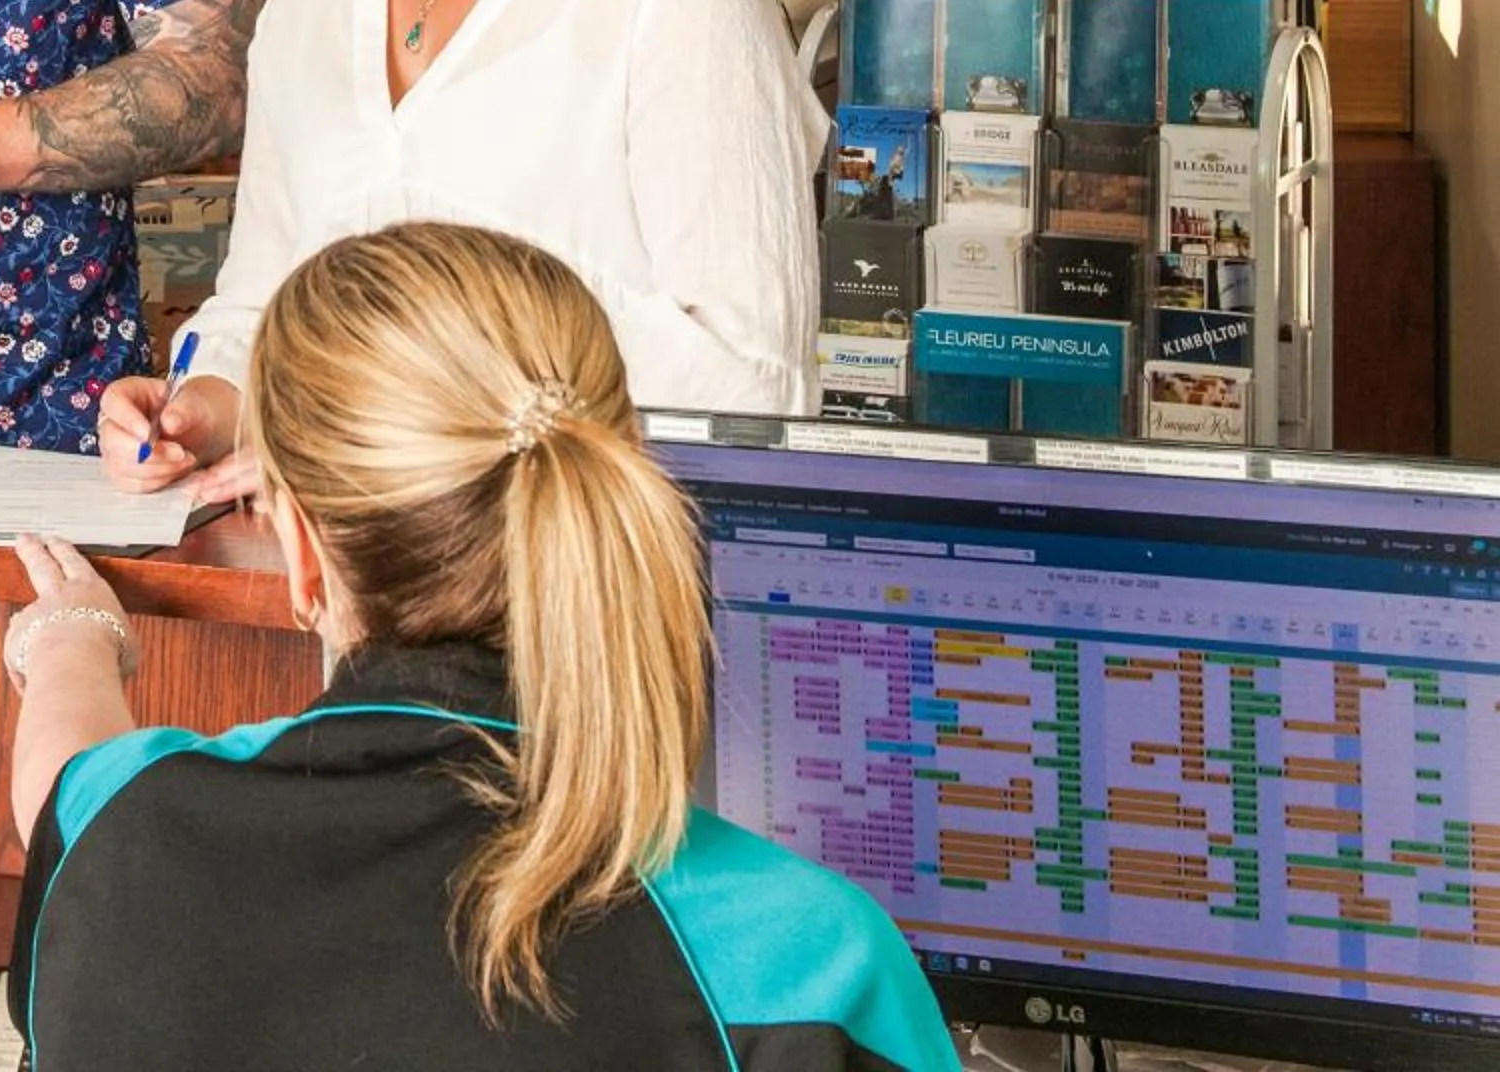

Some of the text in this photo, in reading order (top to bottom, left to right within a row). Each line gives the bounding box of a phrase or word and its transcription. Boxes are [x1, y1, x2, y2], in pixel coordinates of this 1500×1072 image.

[1173, 159, 1248, 175] BLEASDALE
[926, 329, 1110, 357] FLEURIEU PENINSULA
[1162, 321, 1249, 357] KIMBOLTON
[1057, 1003, 1086, 1024] LG
